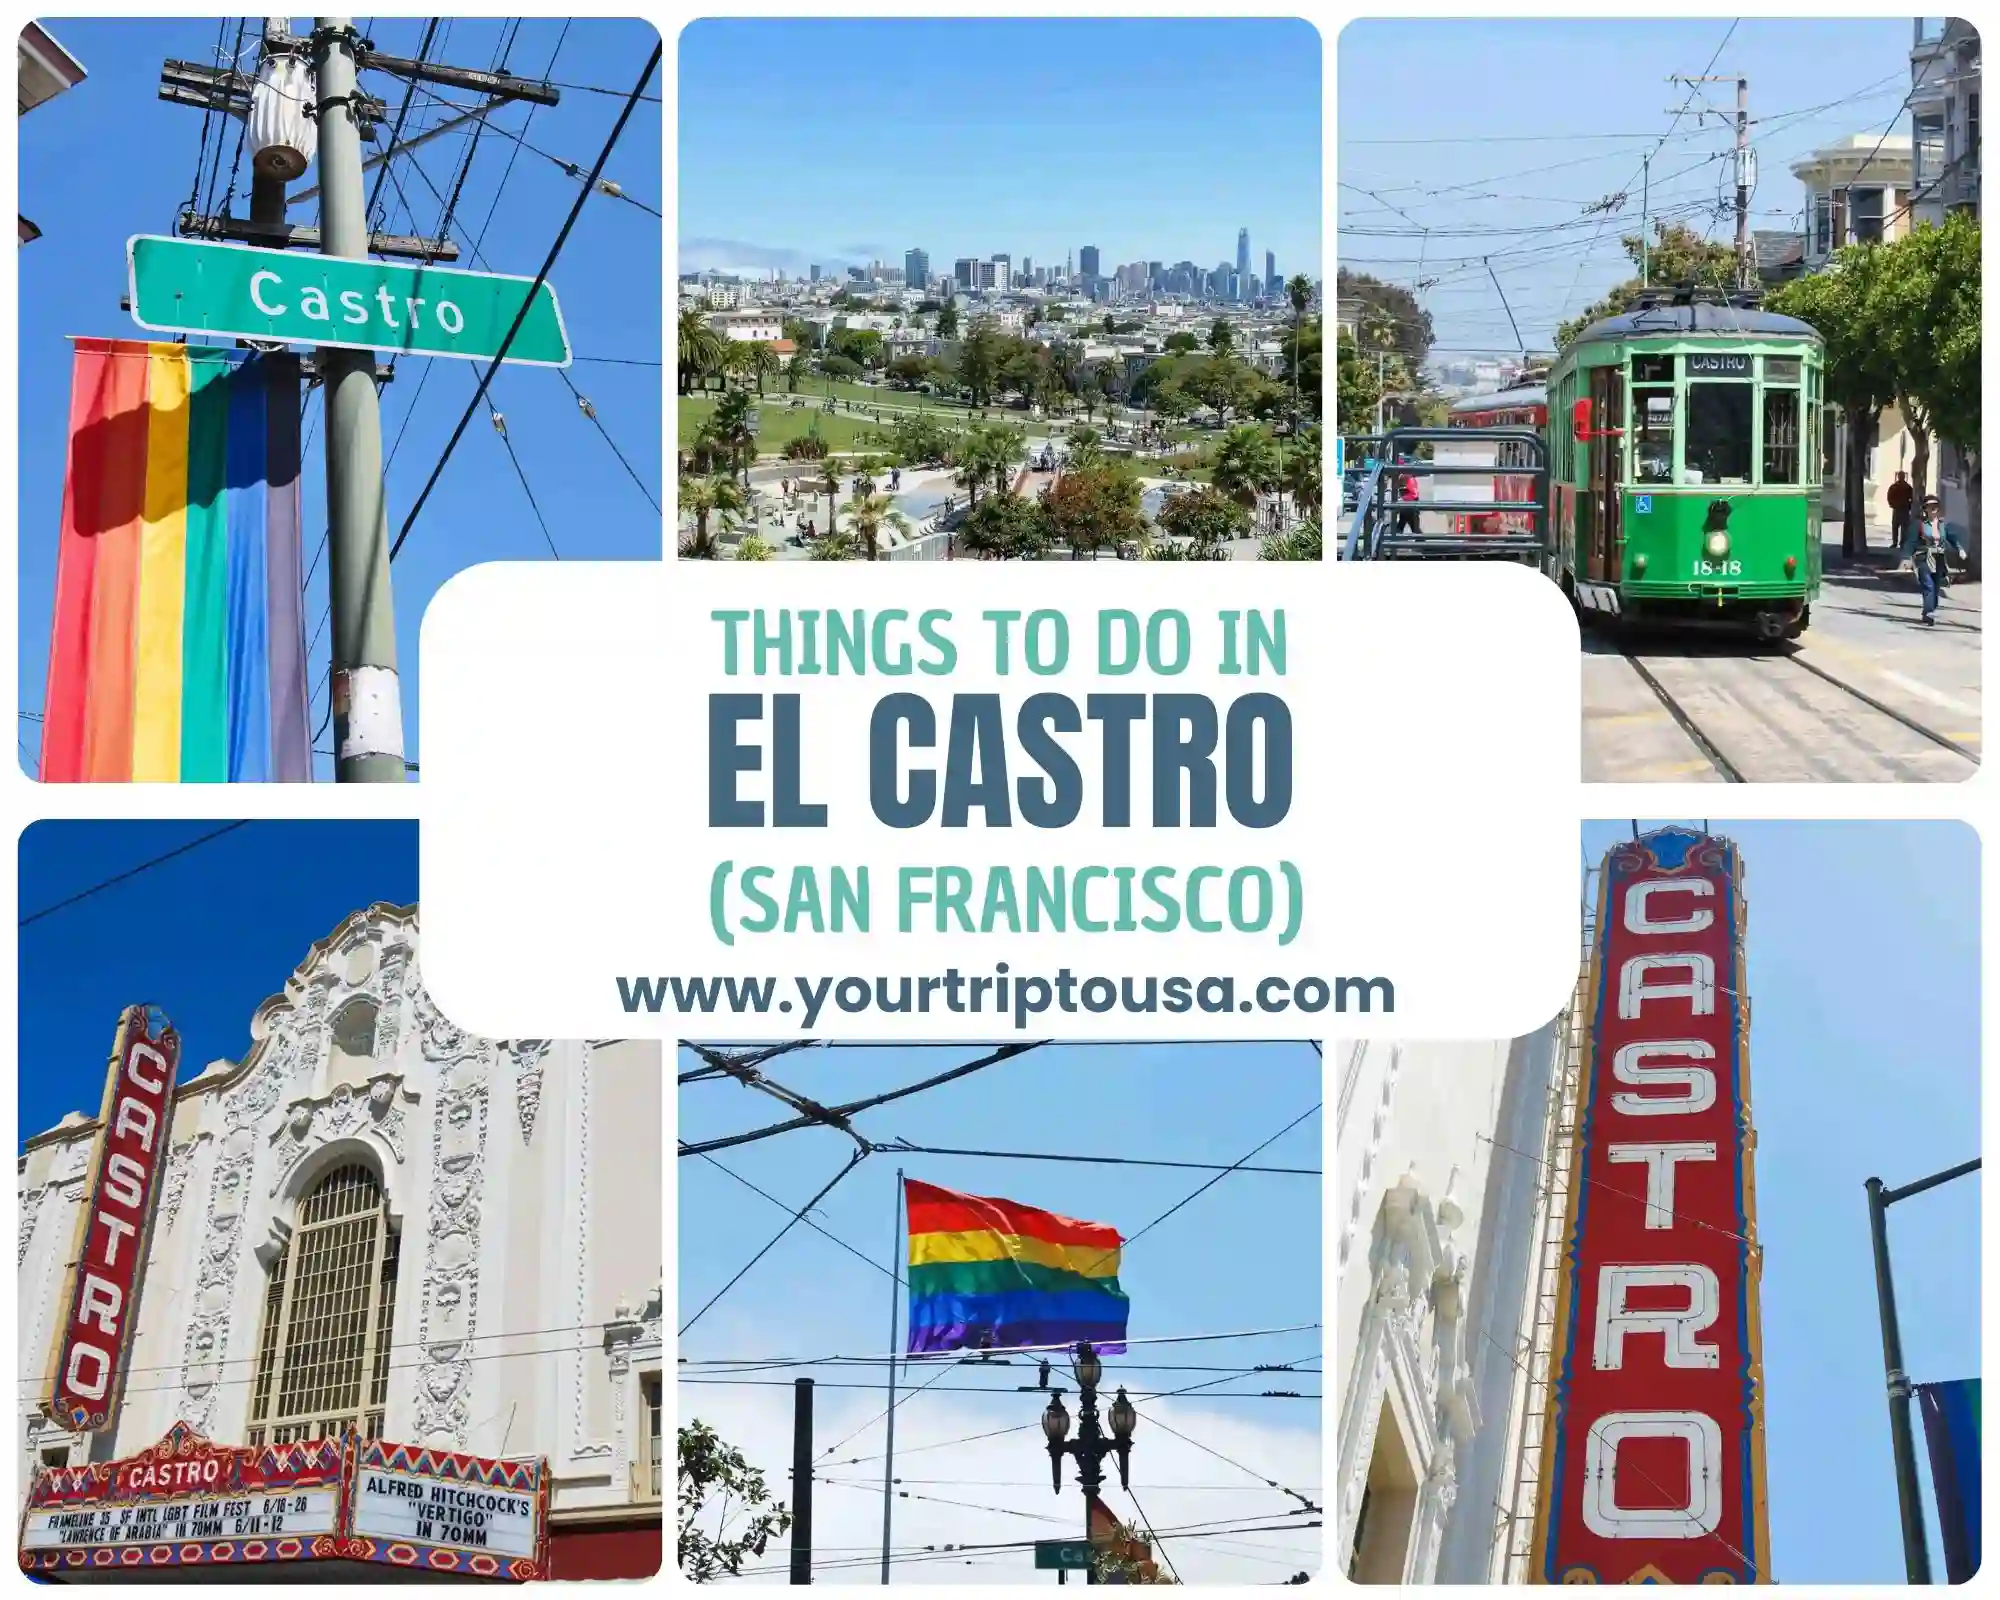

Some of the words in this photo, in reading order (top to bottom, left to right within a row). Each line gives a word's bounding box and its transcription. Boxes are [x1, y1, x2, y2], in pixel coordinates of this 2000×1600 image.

[249, 270, 465, 334] Castro
[1692, 355, 1746, 370] CASTRO
[66, 1042, 166, 1400] CASTRO
[1582, 877, 1724, 1540] CASTRO
[129, 1460, 219, 1489] CASTRO
[366, 1476, 423, 1499] ALFRED
[431, 1486, 529, 1516] HITCHCOCK'S
[48, 1512, 95, 1529] FRAMELINE
[163, 1505, 189, 1521] LGBT
[193, 1502, 219, 1519] FILM
[223, 1500, 251, 1517] FEST
[408, 1501, 493, 1527] "VERTIGO"
[109, 1527, 120, 1541] OF
[191, 1519, 223, 1537] 70MM
[416, 1521, 433, 1539] IN
[440, 1525, 488, 1546] 70MM
